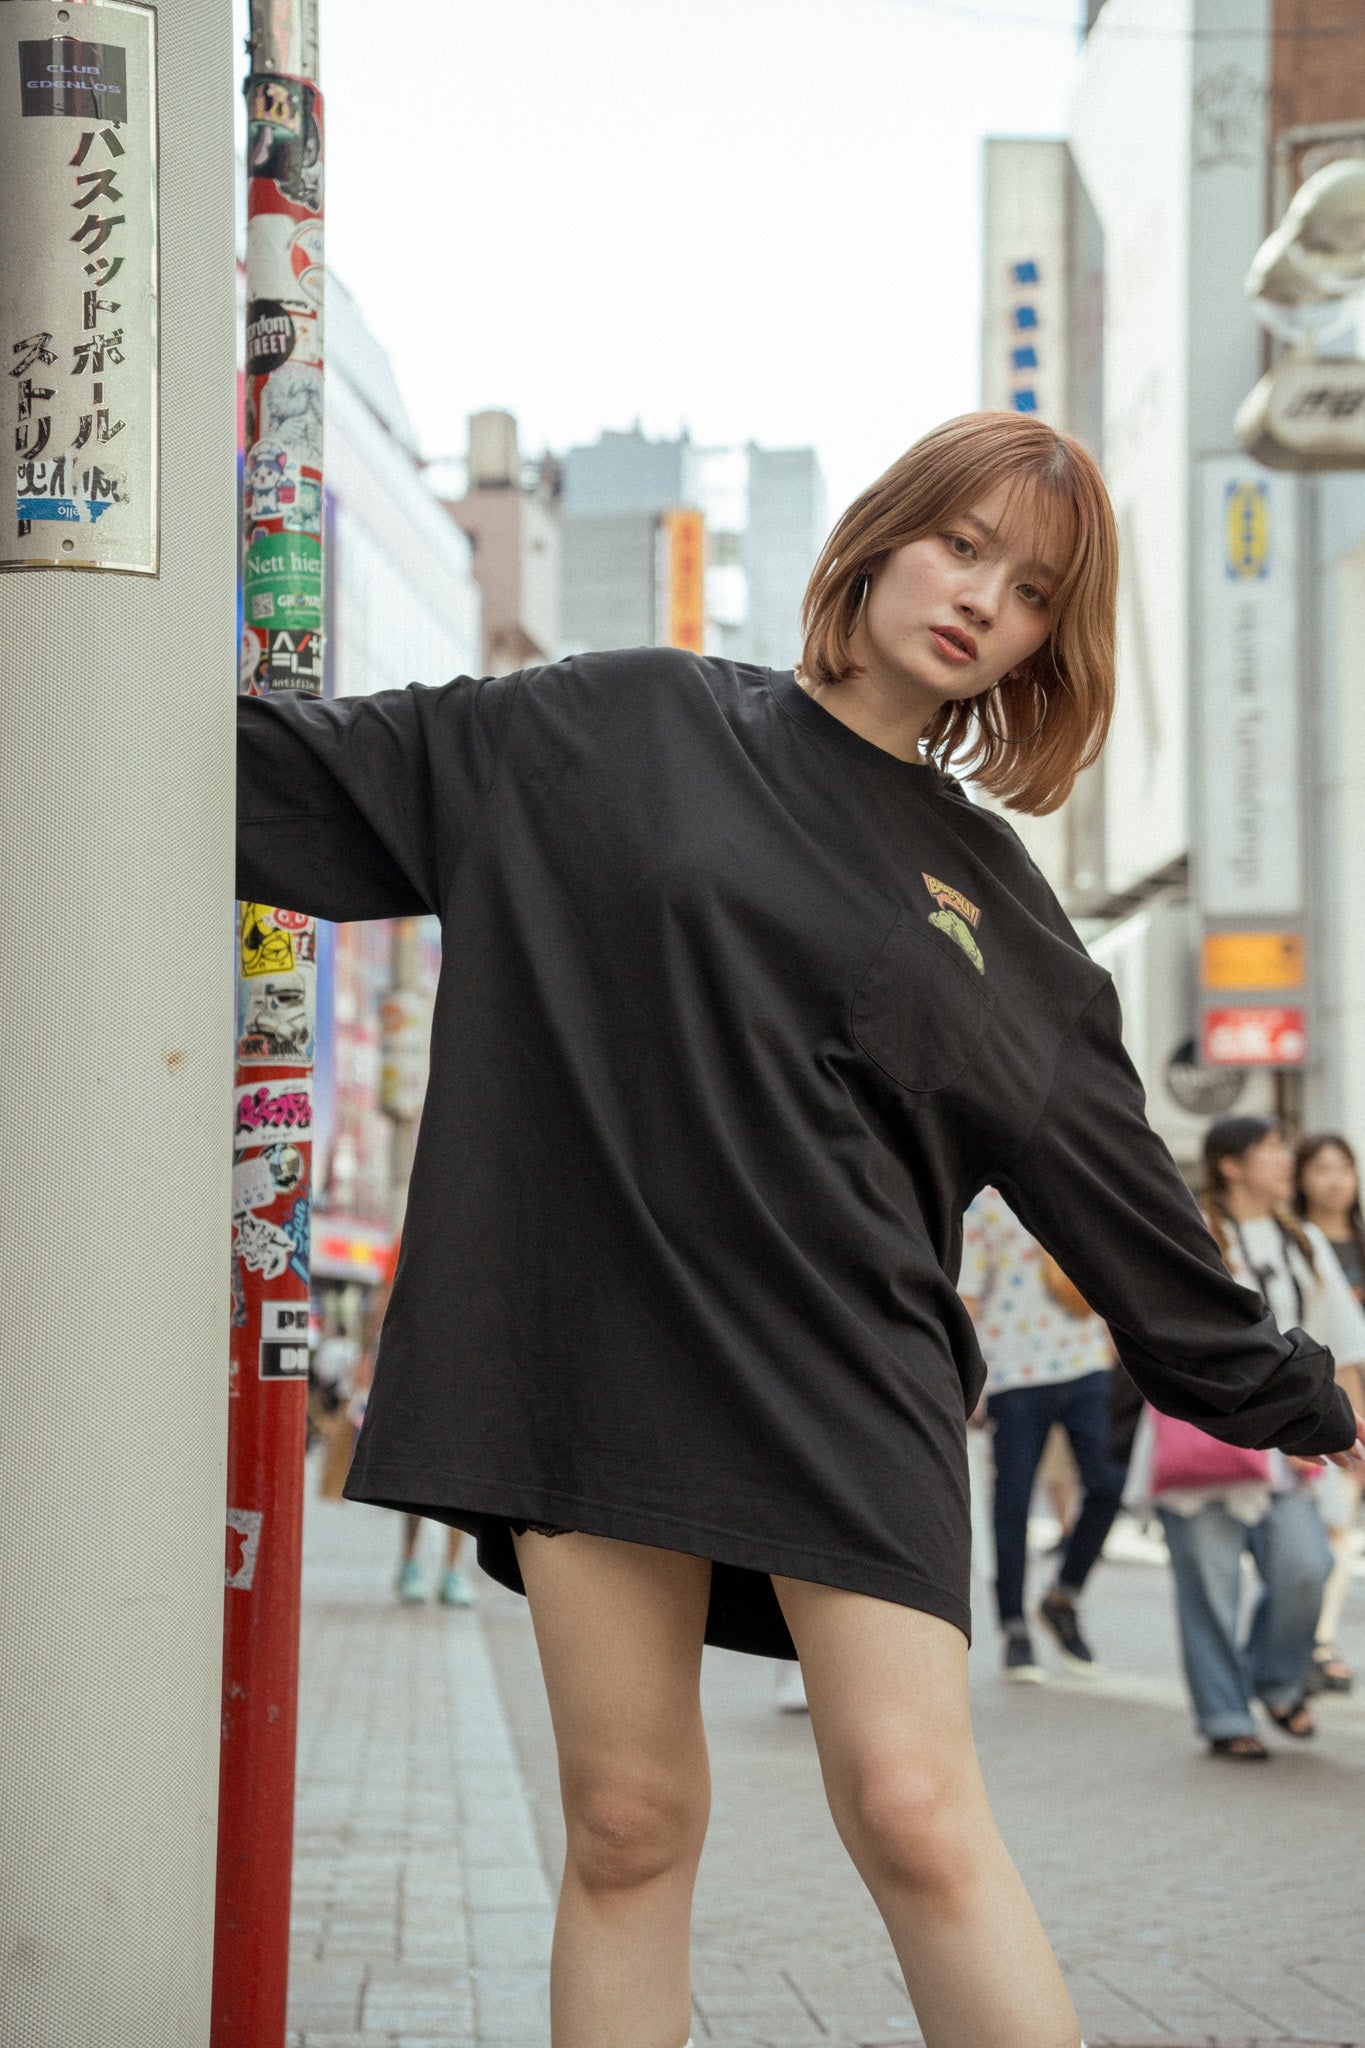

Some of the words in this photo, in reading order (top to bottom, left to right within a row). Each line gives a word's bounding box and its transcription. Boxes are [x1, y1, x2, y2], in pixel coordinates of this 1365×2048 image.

[46, 64, 101, 76] CLUB
[26, 80, 122, 94] EDENLOS
[69, 119, 126, 449] バスケットボール
[57, 506, 81, 518] ello
[246, 555, 286, 577] Nett
